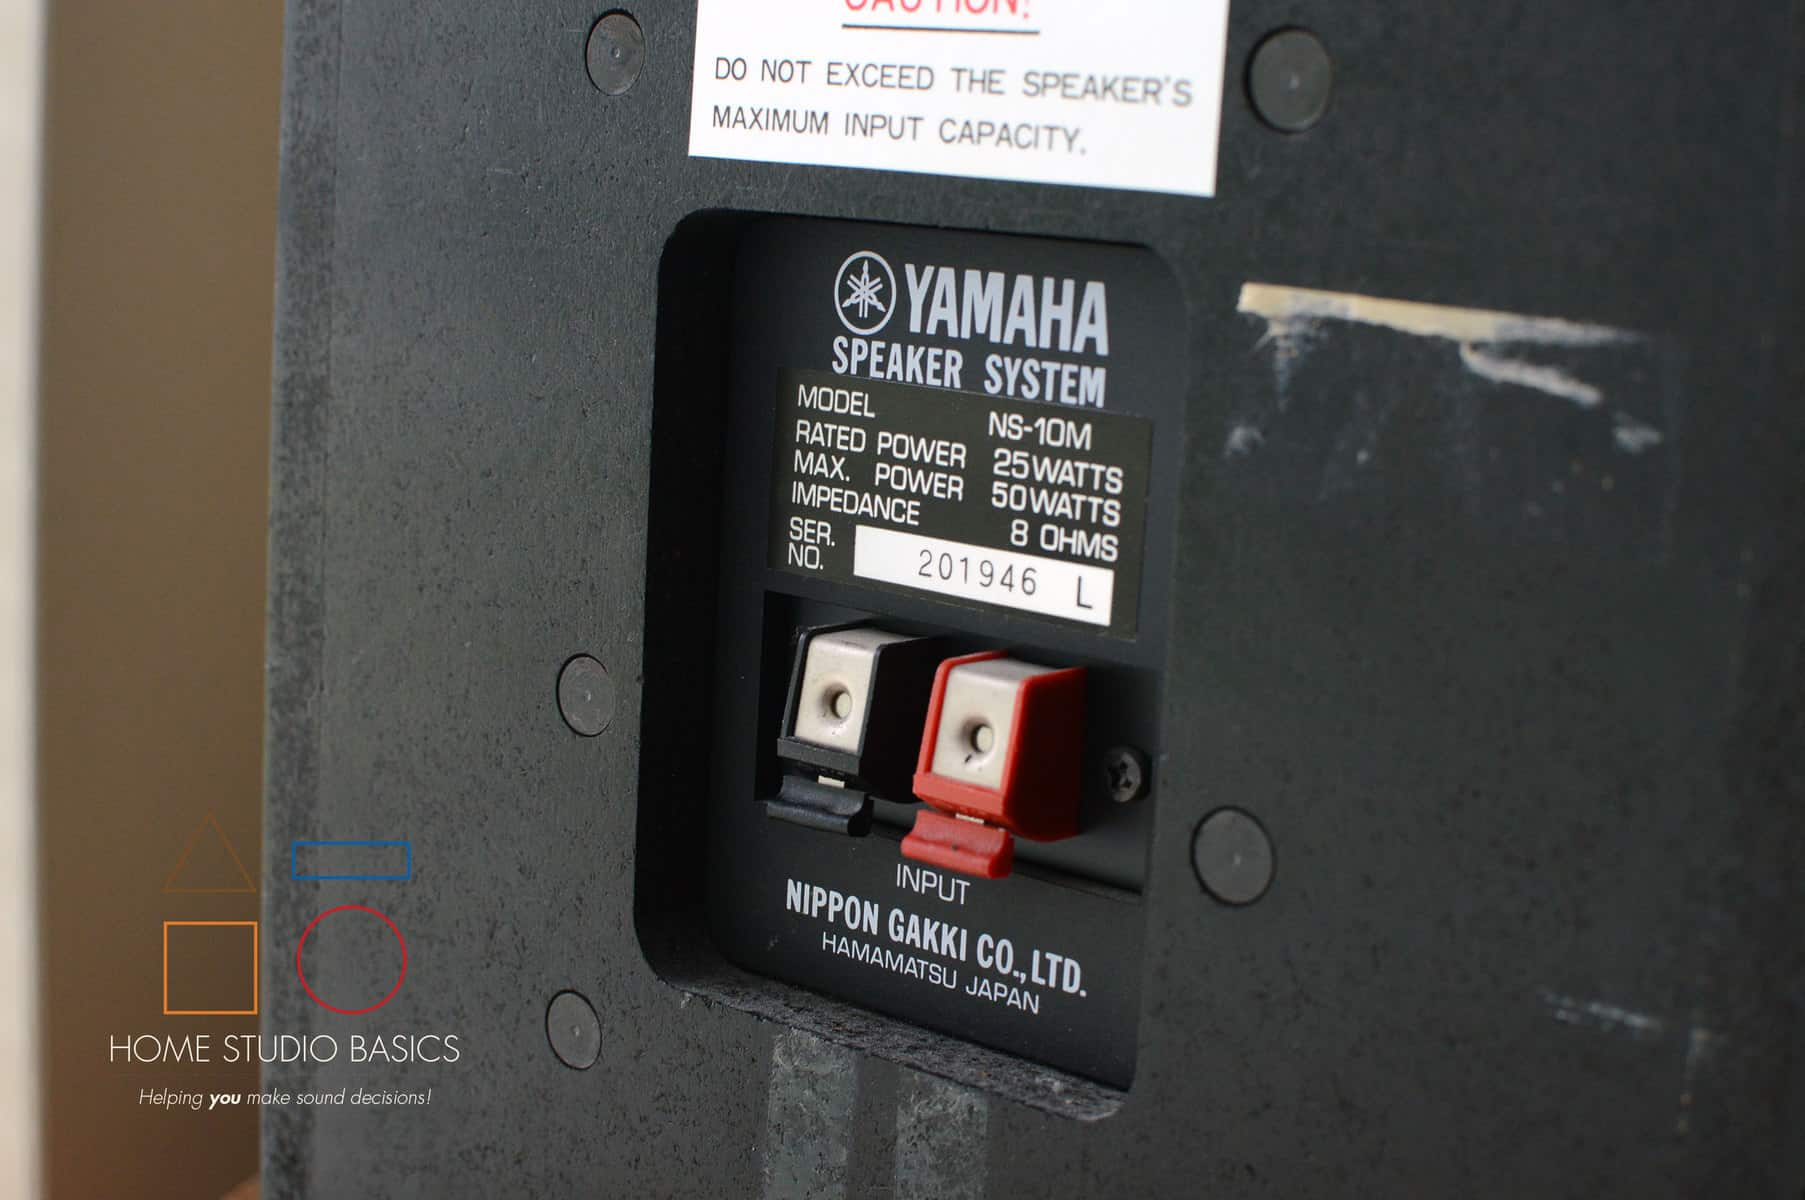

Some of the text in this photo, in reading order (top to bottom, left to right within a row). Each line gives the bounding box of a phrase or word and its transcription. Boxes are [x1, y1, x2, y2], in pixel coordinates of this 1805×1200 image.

[715, 57, 1193, 107] DO NOT EXCEED THE SPEAKER'S
[712, 105, 1087, 155] MAXIMUM INPUT CAPACITY.
[904, 263, 1109, 356] YAMAHA
[832, 335, 1106, 409] SPEAKER SYSTEM
[795, 419, 867, 453] RATED
[876, 431, 967, 469] POWER
[797, 384, 1092, 451] MODEL NS-10M
[793, 450, 851, 482] MAX.
[874, 463, 964, 502] POWER
[788, 516, 836, 547] SER.
[790, 480, 1119, 564] IMPEDANCE 8 OHMS
[787, 543, 825, 571] NO.
[918, 549, 1094, 610] 201946 L
[896, 863, 971, 906] INPUT
[785, 878, 880, 936] NIPPON
[888, 908, 968, 962] GAKKI
[822, 931, 1040, 1015] HAMAMATSU JAPAN
